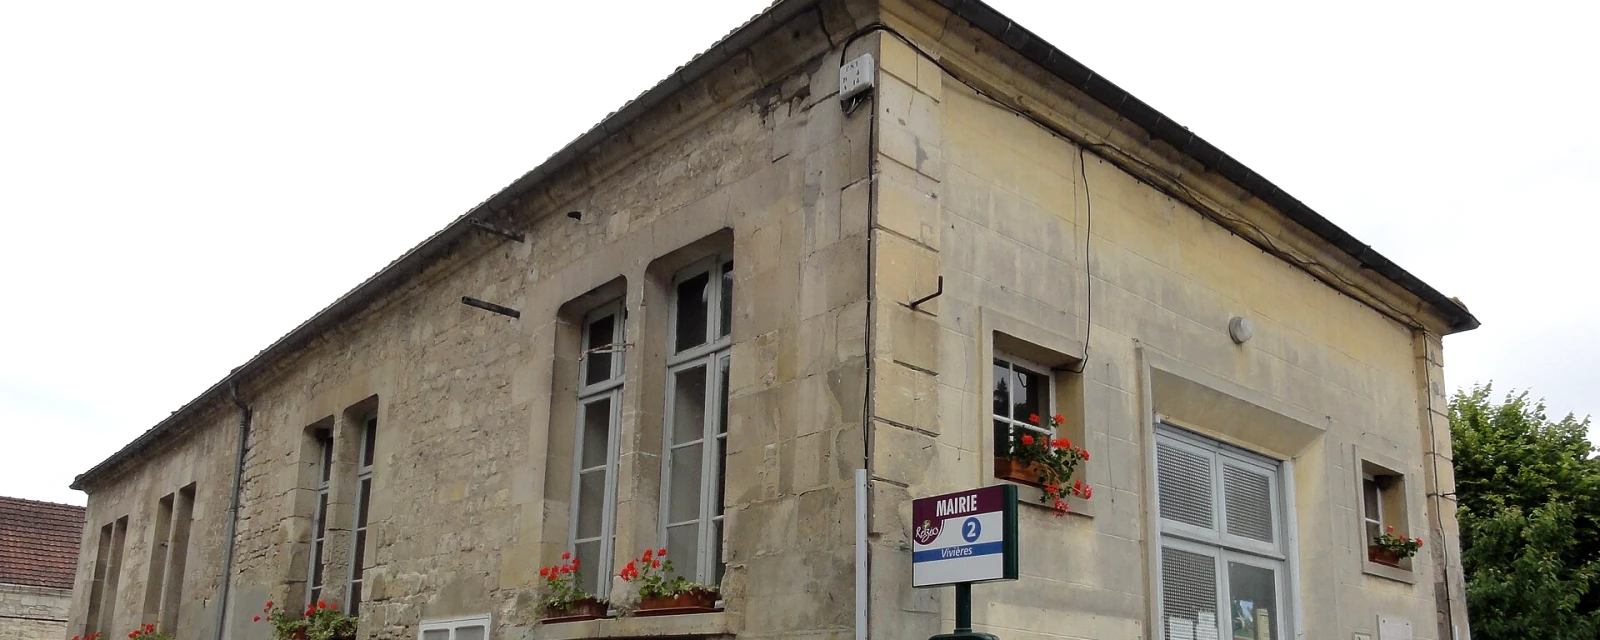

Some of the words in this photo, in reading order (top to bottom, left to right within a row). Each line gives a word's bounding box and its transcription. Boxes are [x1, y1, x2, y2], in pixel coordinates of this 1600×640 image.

[936, 494, 977, 517] MAIRIE
[967, 521, 976, 538] 2
[941, 546, 973, 558] Vivières
